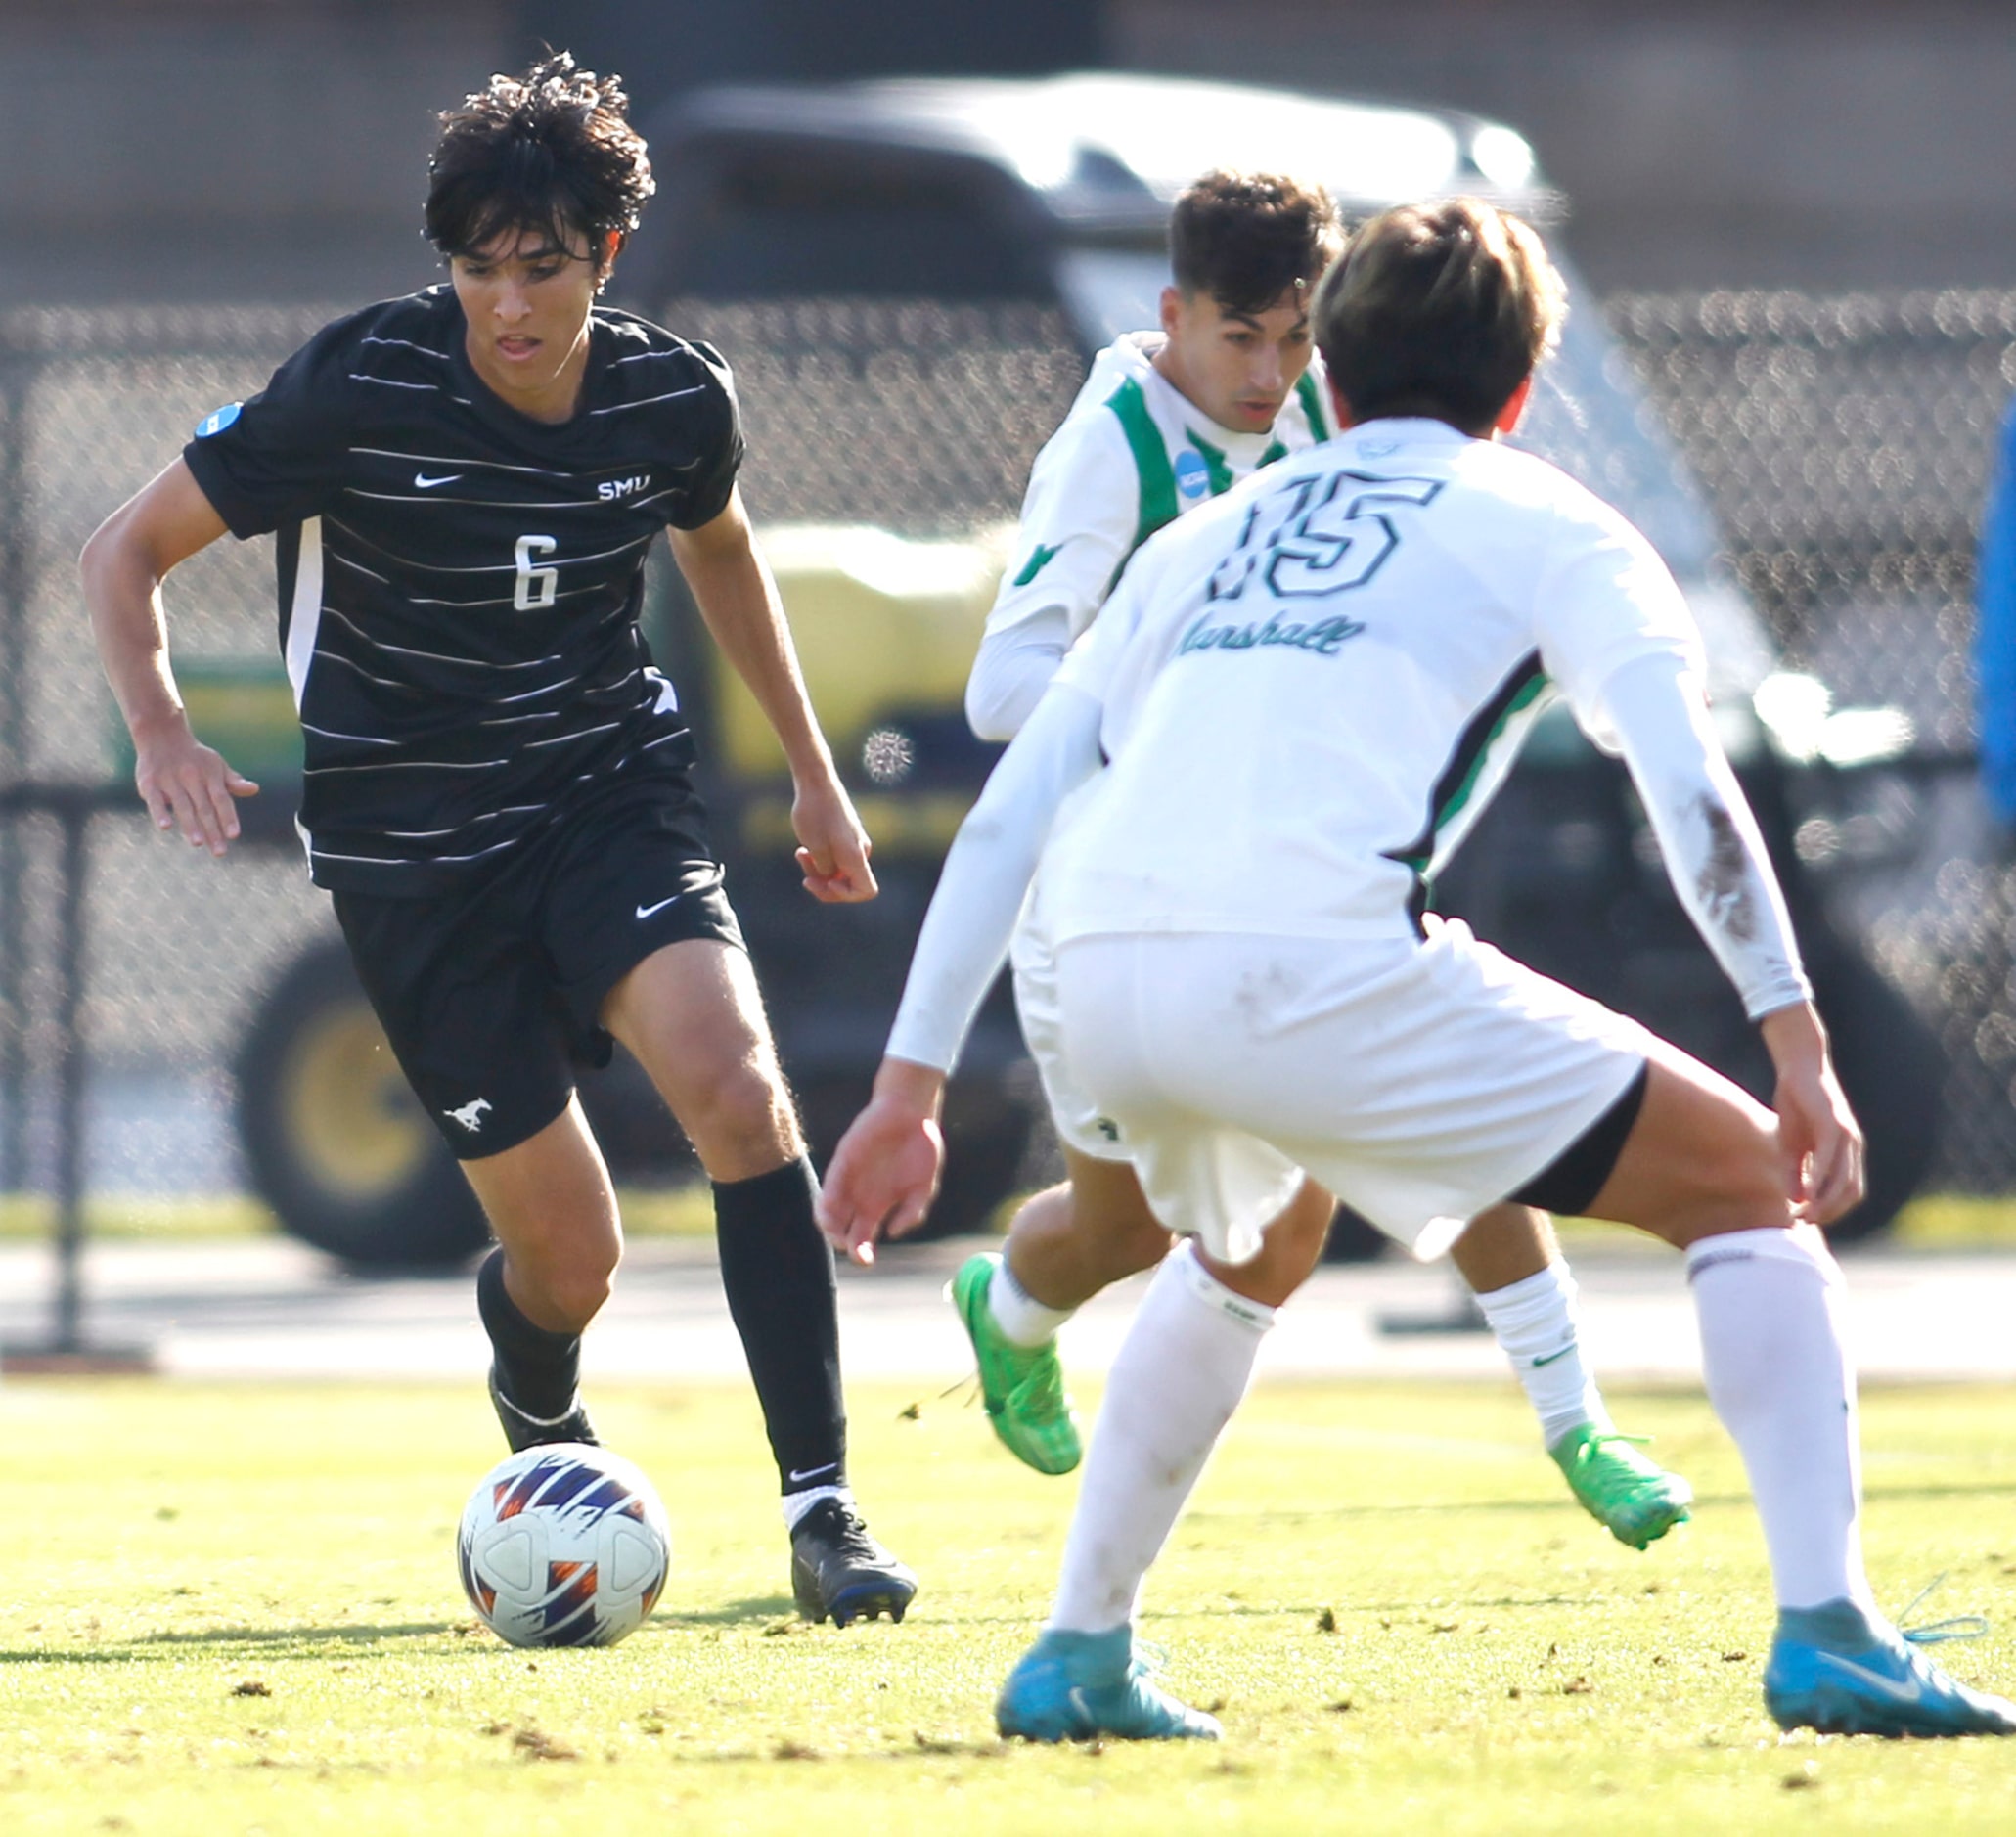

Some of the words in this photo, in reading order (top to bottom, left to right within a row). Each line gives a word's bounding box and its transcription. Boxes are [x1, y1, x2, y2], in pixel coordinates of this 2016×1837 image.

[598, 475, 650, 500] SMU
[514, 535, 558, 610] 6
[1208, 470, 1445, 602] 15
